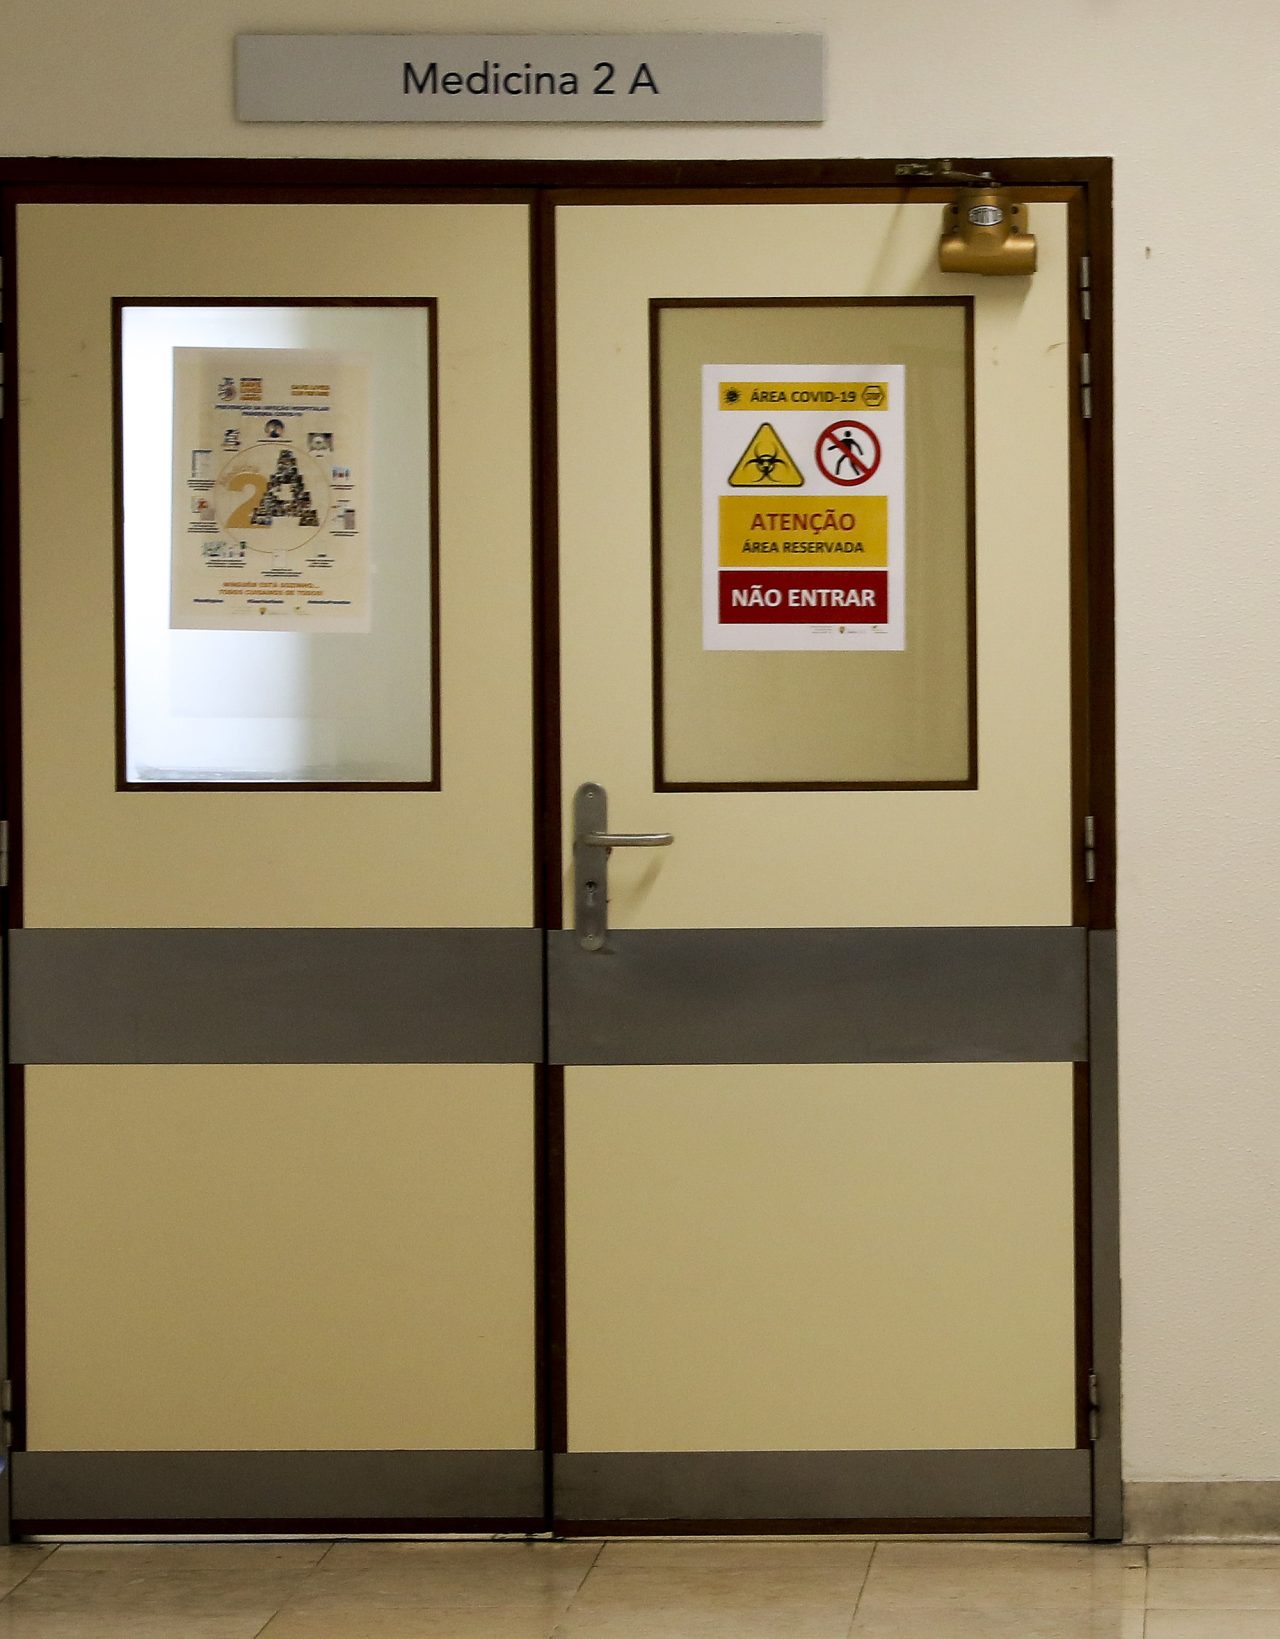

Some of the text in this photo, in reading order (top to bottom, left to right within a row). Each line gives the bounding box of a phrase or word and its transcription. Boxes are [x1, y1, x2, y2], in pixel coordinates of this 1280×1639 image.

[403, 60, 660, 95] Medicina 2 A
[750, 388, 787, 403] ÁREA
[791, 390, 857, 403] COVID-19
[750, 508, 856, 536] ATENÇÃO
[741, 539, 865, 554] ÁREA RESERVADA
[731, 584, 877, 607] NÃO ENTRAR
